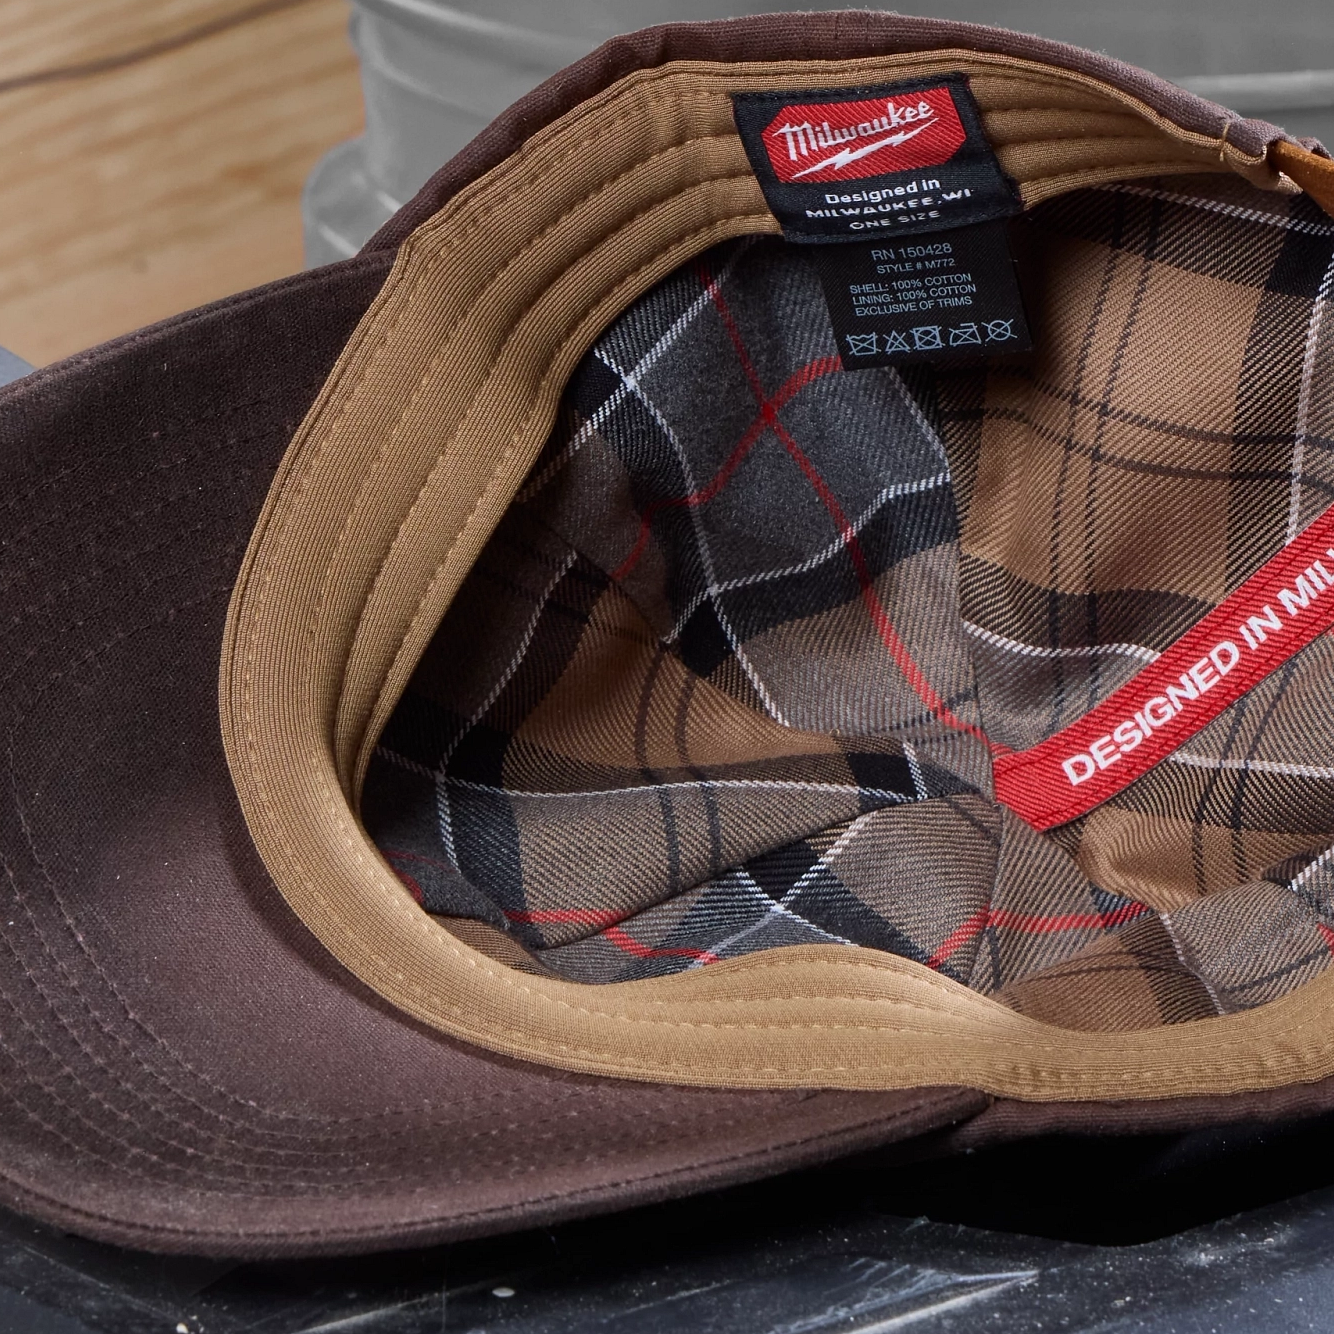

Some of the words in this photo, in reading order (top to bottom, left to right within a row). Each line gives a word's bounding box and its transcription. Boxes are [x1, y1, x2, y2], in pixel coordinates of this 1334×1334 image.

[772, 101, 935, 161] Milwaukee
[825, 181, 918, 204] Designed
[921, 179, 941, 190] in
[849, 218, 892, 230] ONE
[897, 210, 941, 223] SIZE
[871, 249, 895, 261] RN
[899, 243, 953, 259] 150428
[876, 262, 914, 274] STYLE
[924, 258, 955, 269] M772
[849, 284, 889, 294] SHELL:
[891, 279, 922, 289] 100%
[924, 273, 972, 286] COTTON
[852, 295, 894, 305] LINING:
[896, 290, 927, 301] 100%
[929, 284, 977, 297] COTTON
[855, 303, 918, 317] EXCLUSIVE
[919, 299, 935, 310] OF
[937, 295, 973, 308] TRIMS
[1061, 640, 1240, 787] DESIGNED
[1239, 604, 1285, 651] IN
